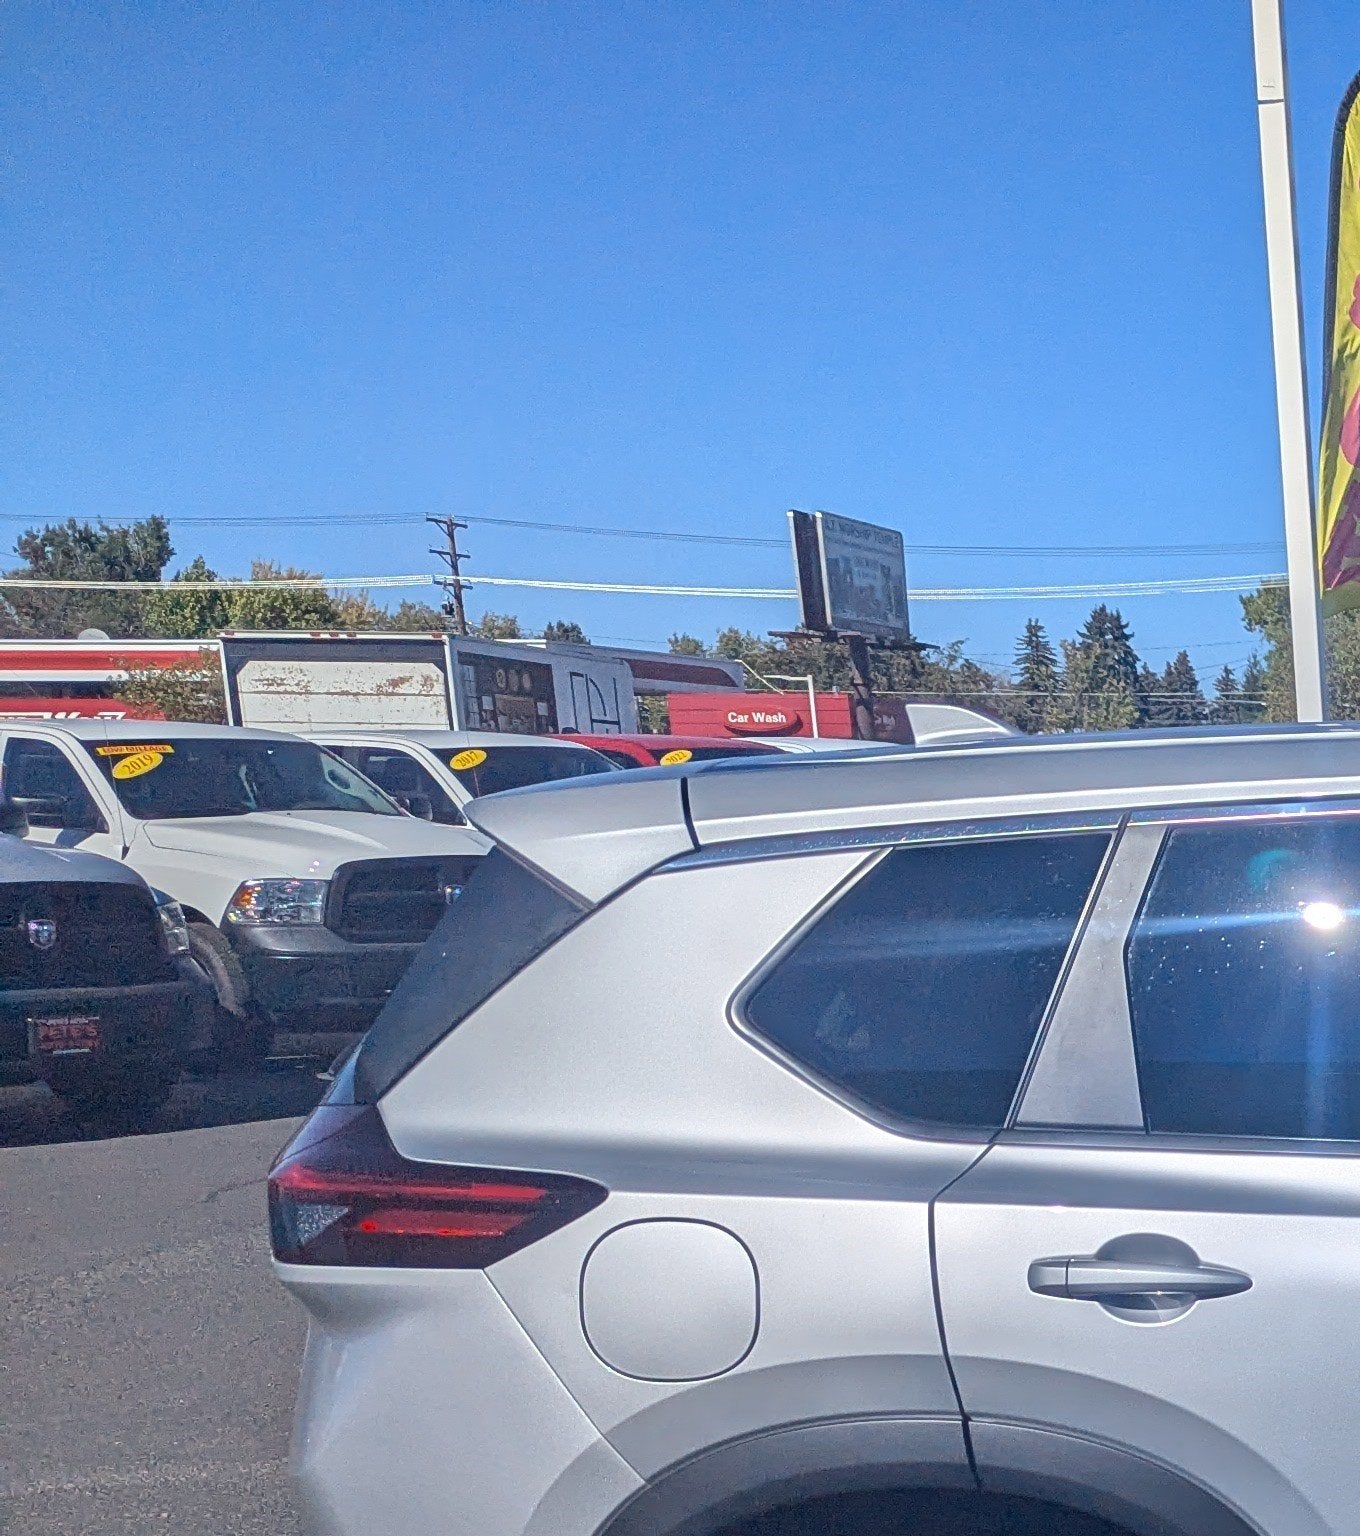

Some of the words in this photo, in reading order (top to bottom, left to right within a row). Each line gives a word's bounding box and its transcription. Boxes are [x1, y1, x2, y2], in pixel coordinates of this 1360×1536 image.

[727, 713, 748, 723] Car
[751, 712, 787, 723] Wash
[122, 754, 154, 775] 2019
[455, 751, 479, 768] 2017
